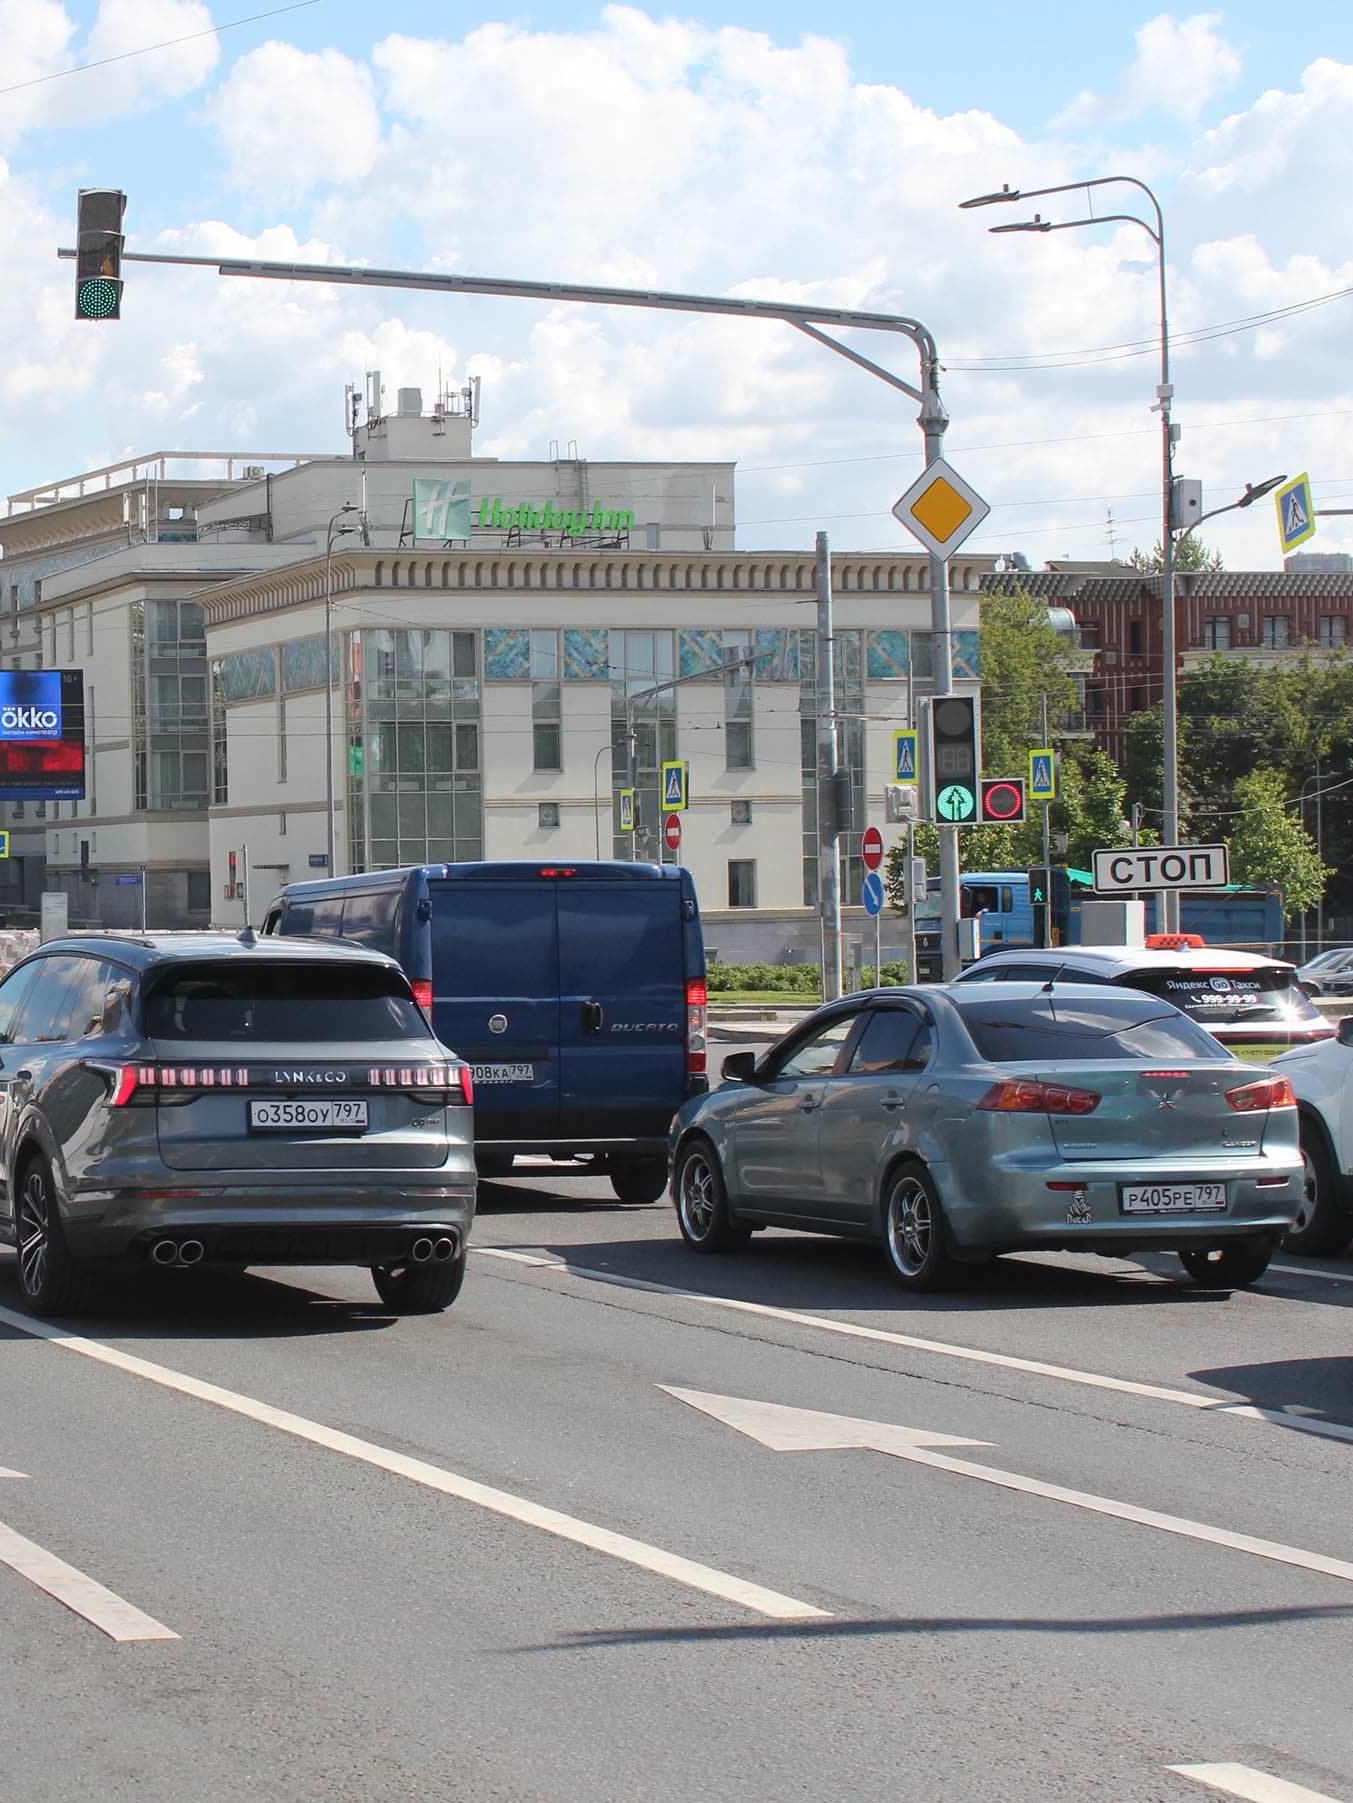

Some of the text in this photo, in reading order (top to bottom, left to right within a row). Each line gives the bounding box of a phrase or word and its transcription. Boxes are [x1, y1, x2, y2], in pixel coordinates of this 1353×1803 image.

[478, 498, 635, 538] Holiday Inn
[1110, 854, 1211, 884] СТОП
[1167, 980, 1210, 990] Яндекс
[1230, 980, 1261, 989] Такси
[1201, 994, 1257, 1003] 999-99-99
[610, 1023, 679, 1032] DUCATO
[275, 1071, 346, 1083] LYNK&CO
